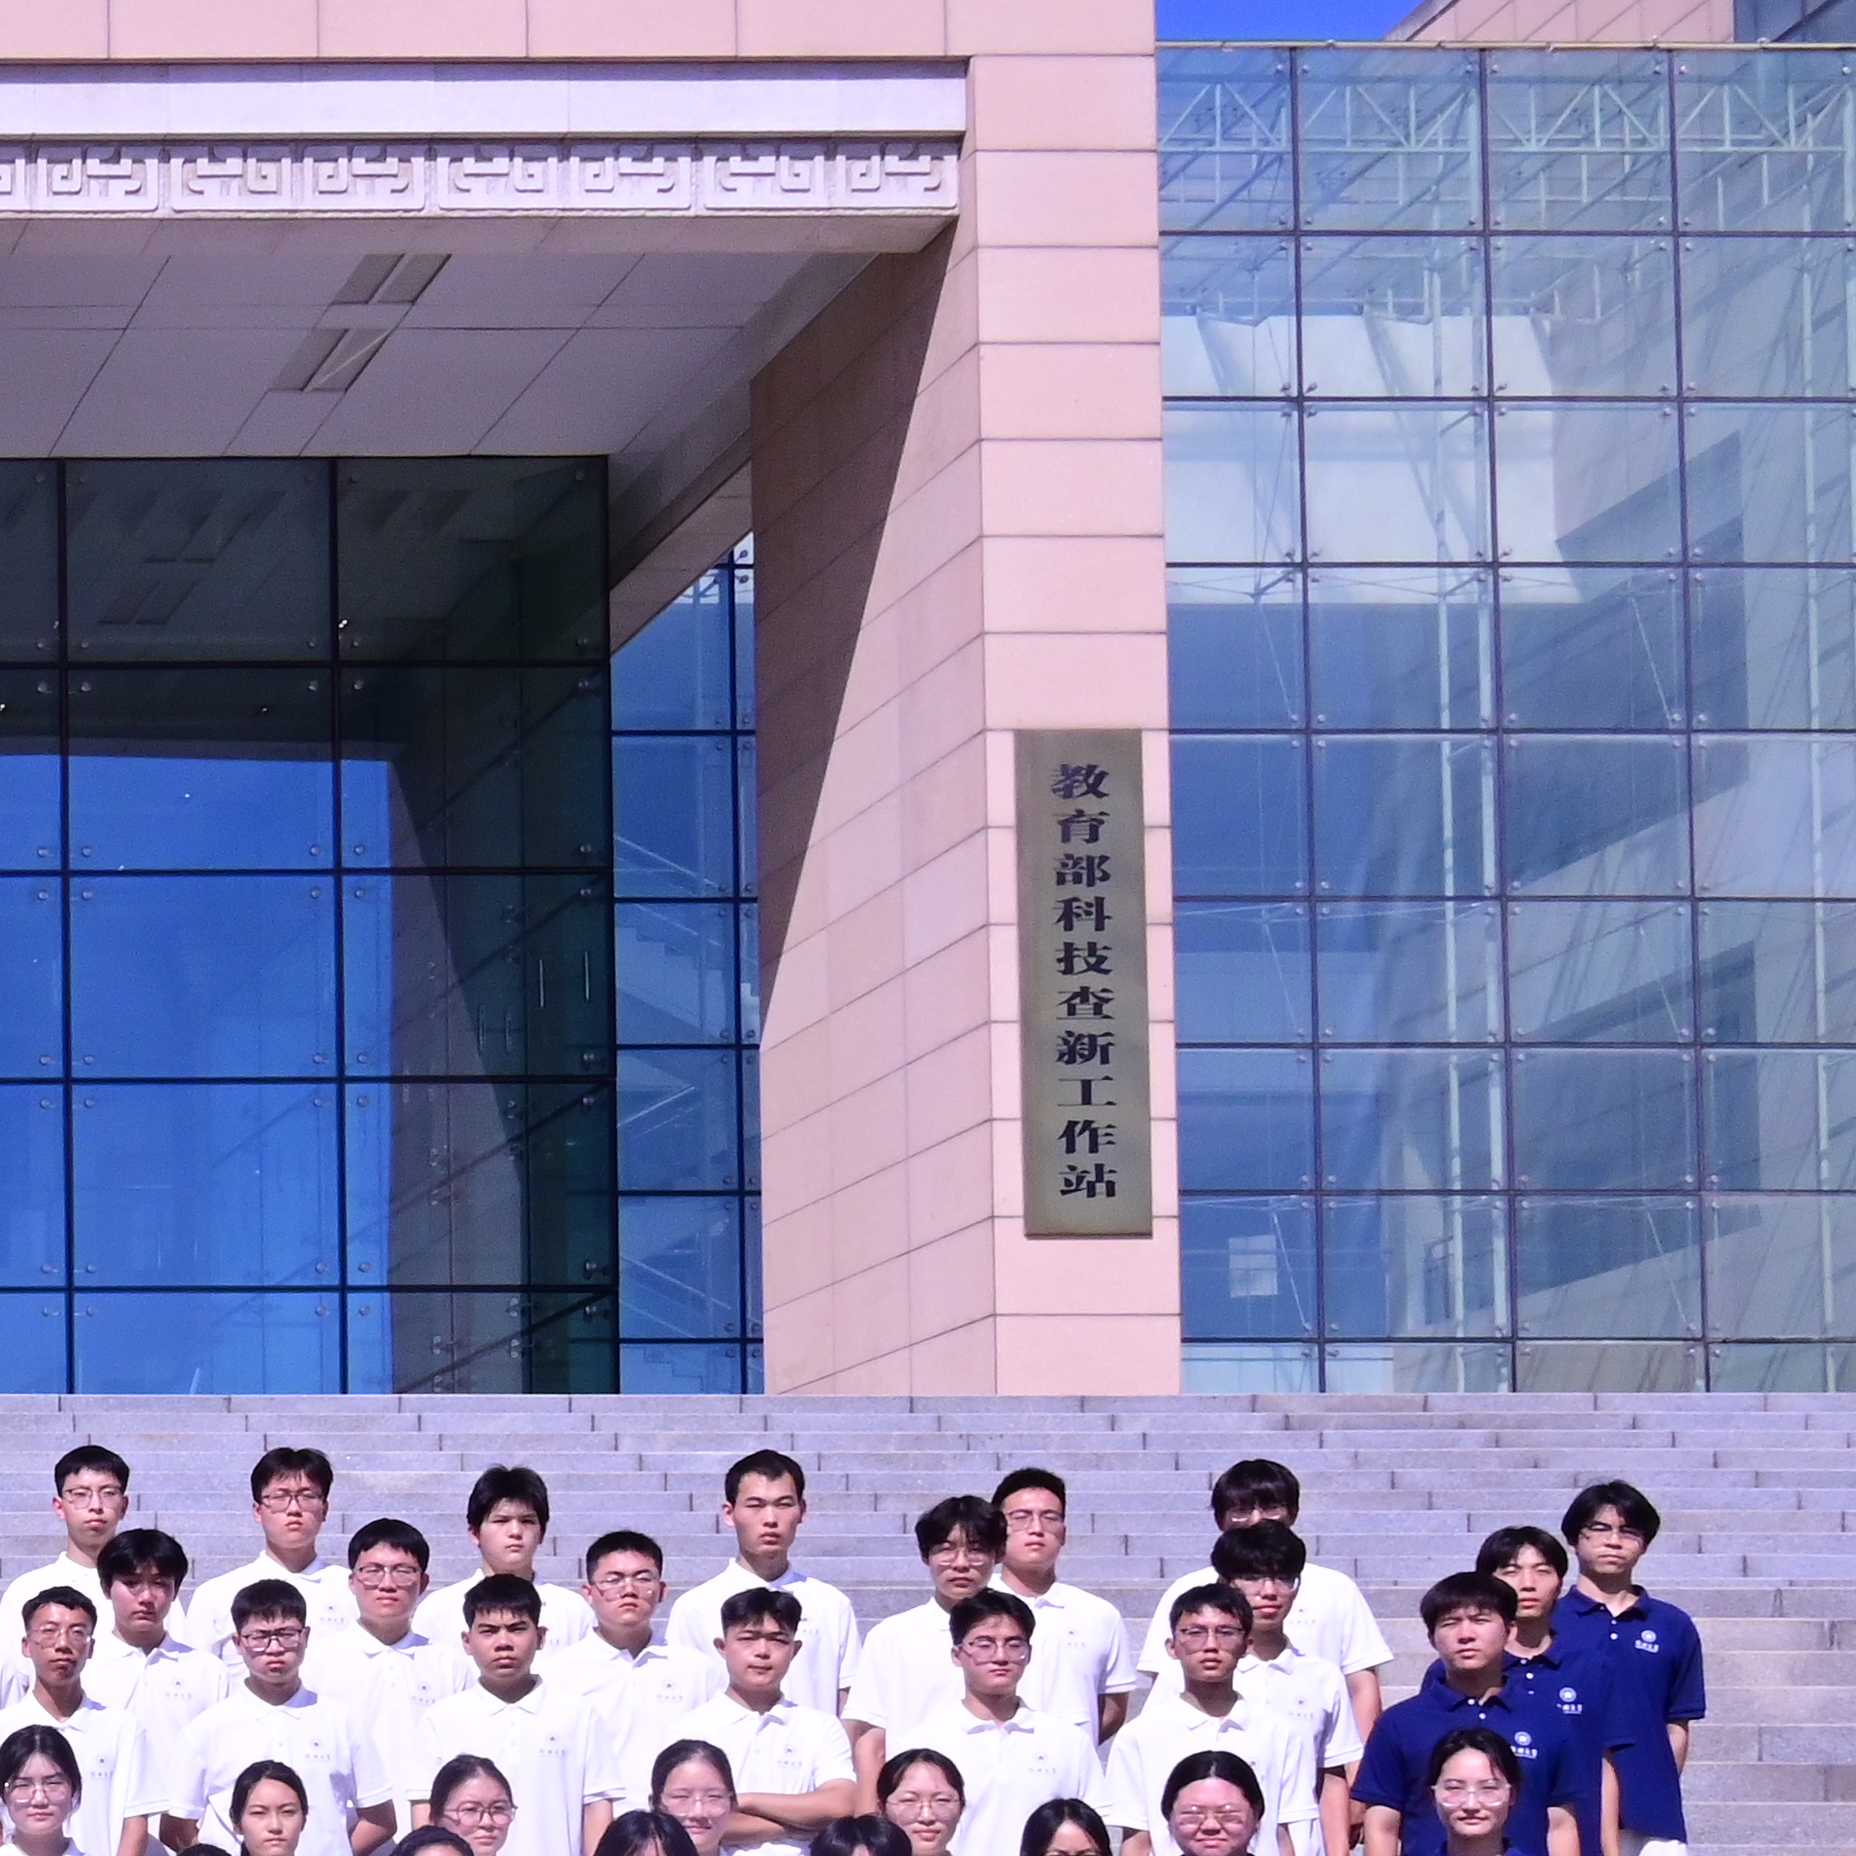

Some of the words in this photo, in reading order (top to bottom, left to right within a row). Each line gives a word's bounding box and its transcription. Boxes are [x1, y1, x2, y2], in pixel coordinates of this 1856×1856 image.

[1051, 763, 1118, 1199] 教育部科技查新工作站
